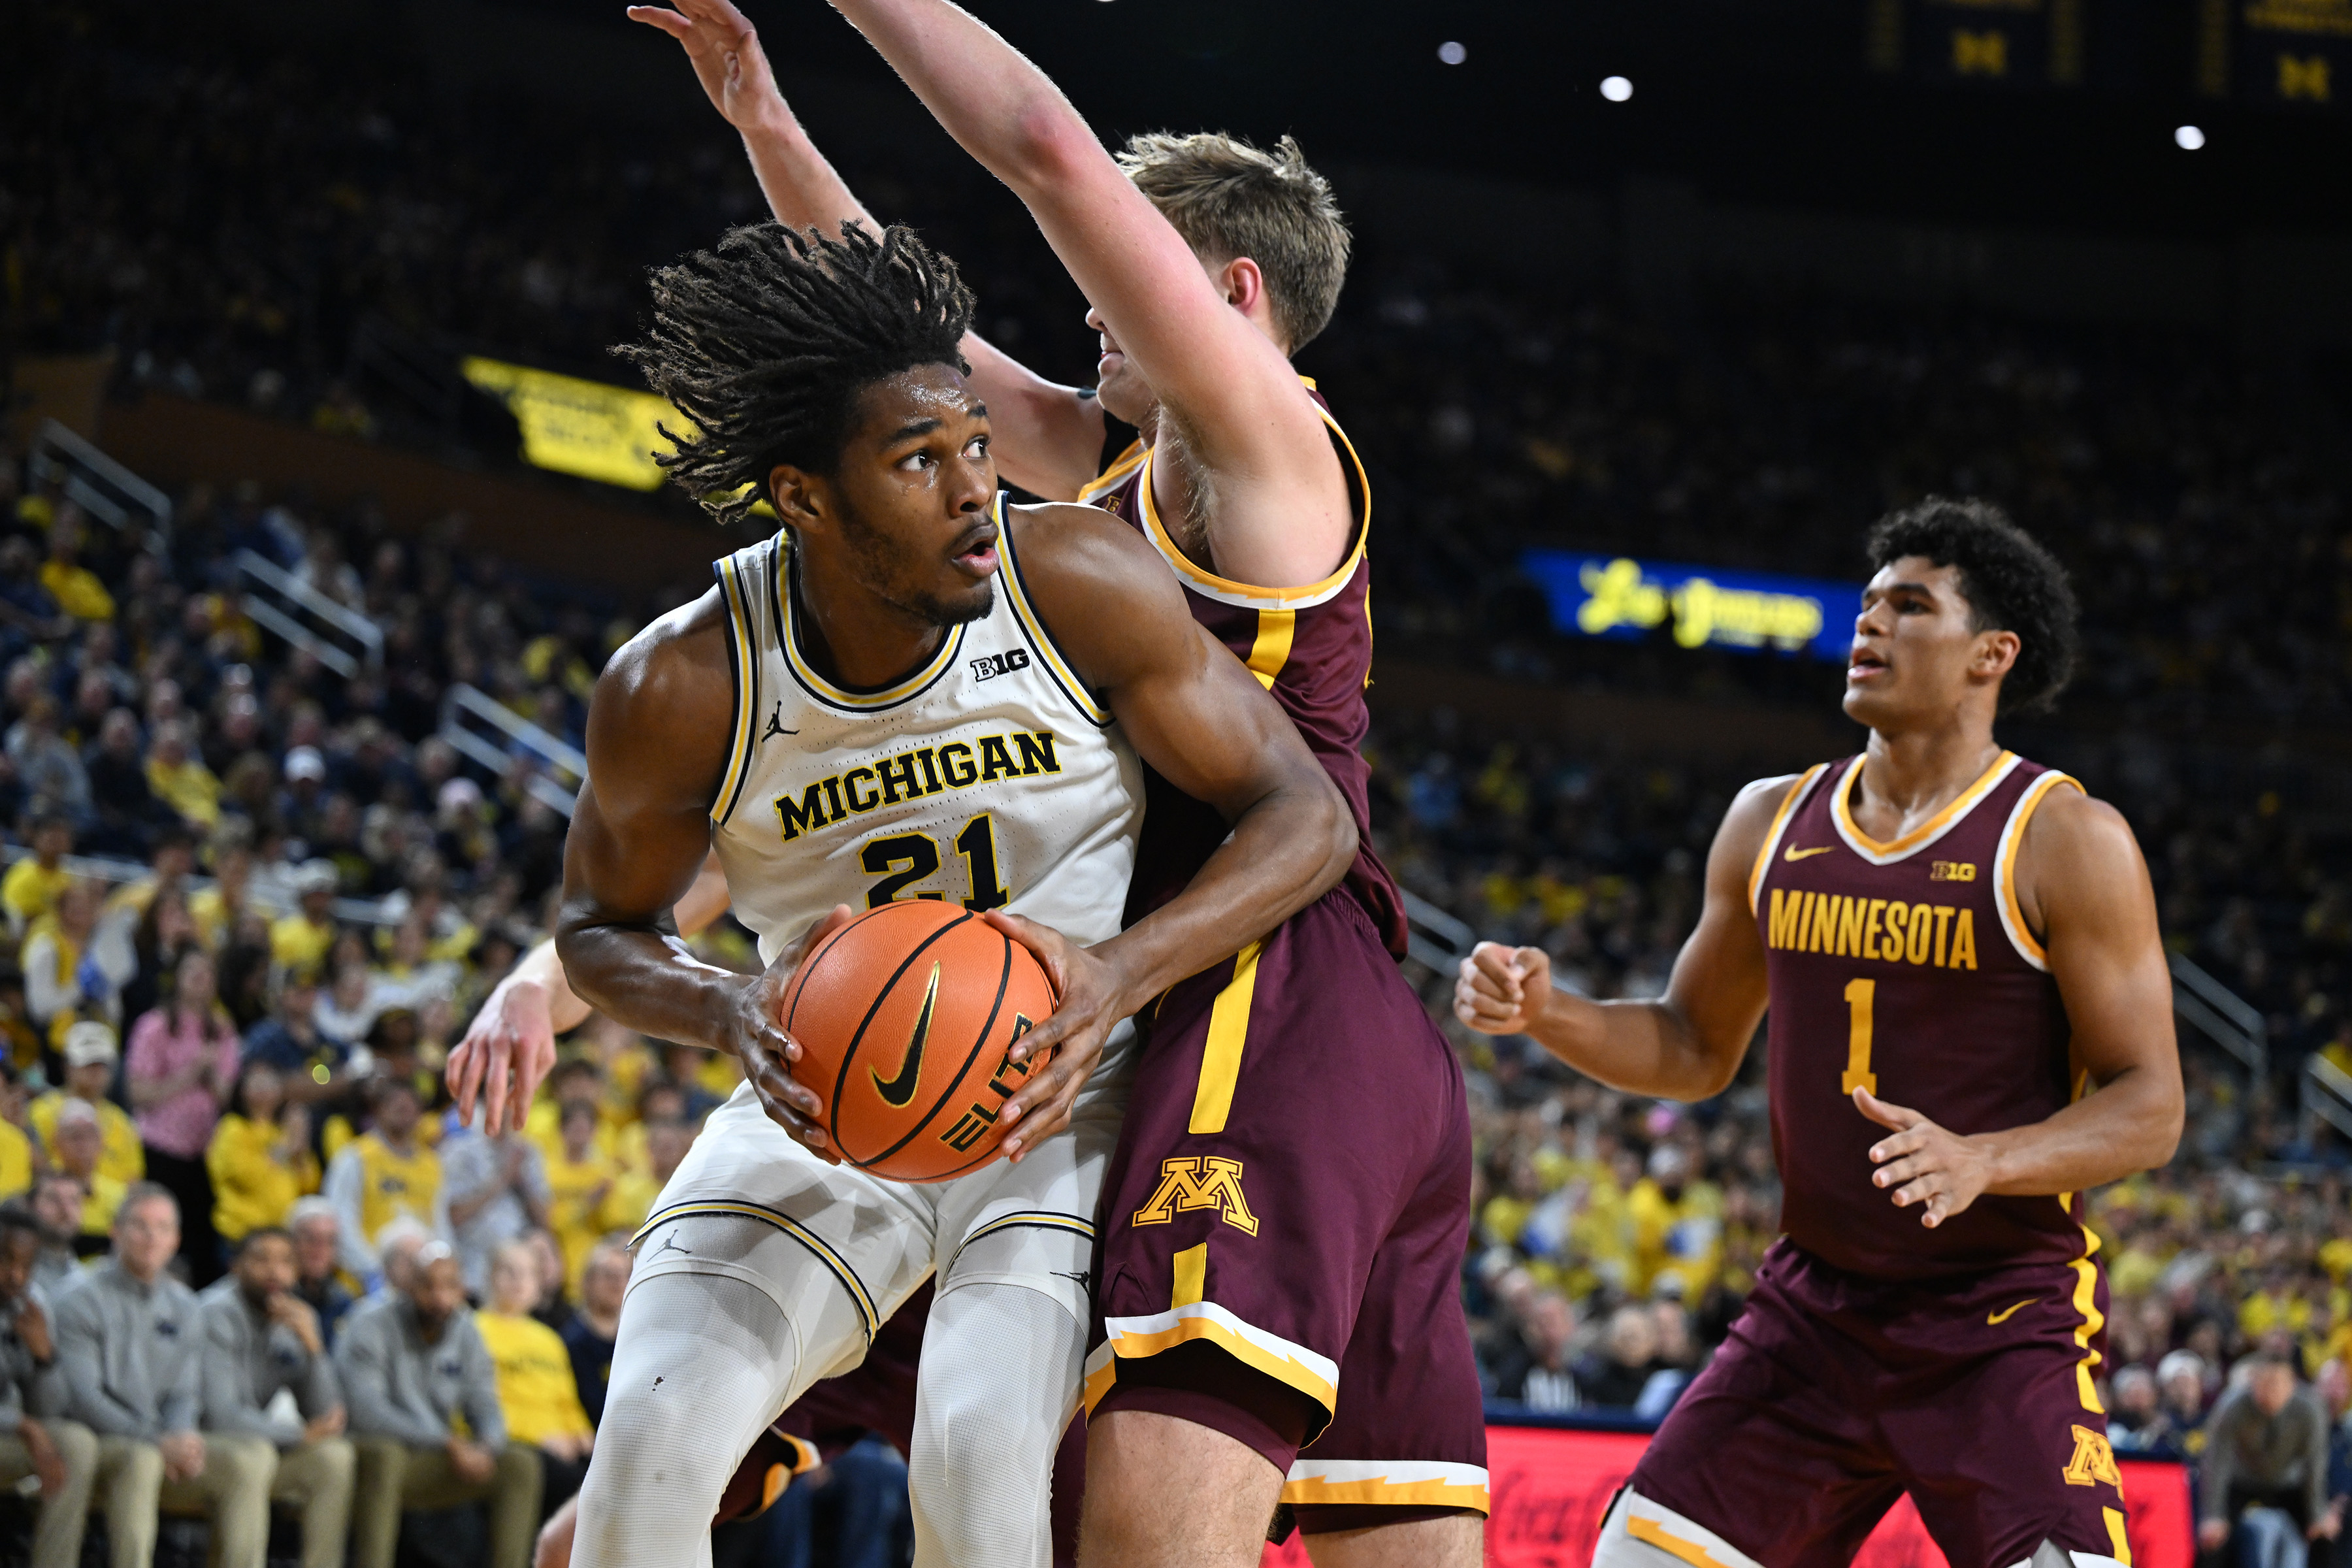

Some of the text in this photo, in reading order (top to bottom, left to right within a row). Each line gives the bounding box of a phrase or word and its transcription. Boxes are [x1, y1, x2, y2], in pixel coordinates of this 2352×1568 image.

[774, 730, 1062, 843] MICHIGAN
[858, 811, 1011, 911] 21
[1768, 888, 1978, 970] MINNESOTA
[1842, 977, 1877, 1096] 1
[1132, 1156, 1260, 1237] M
